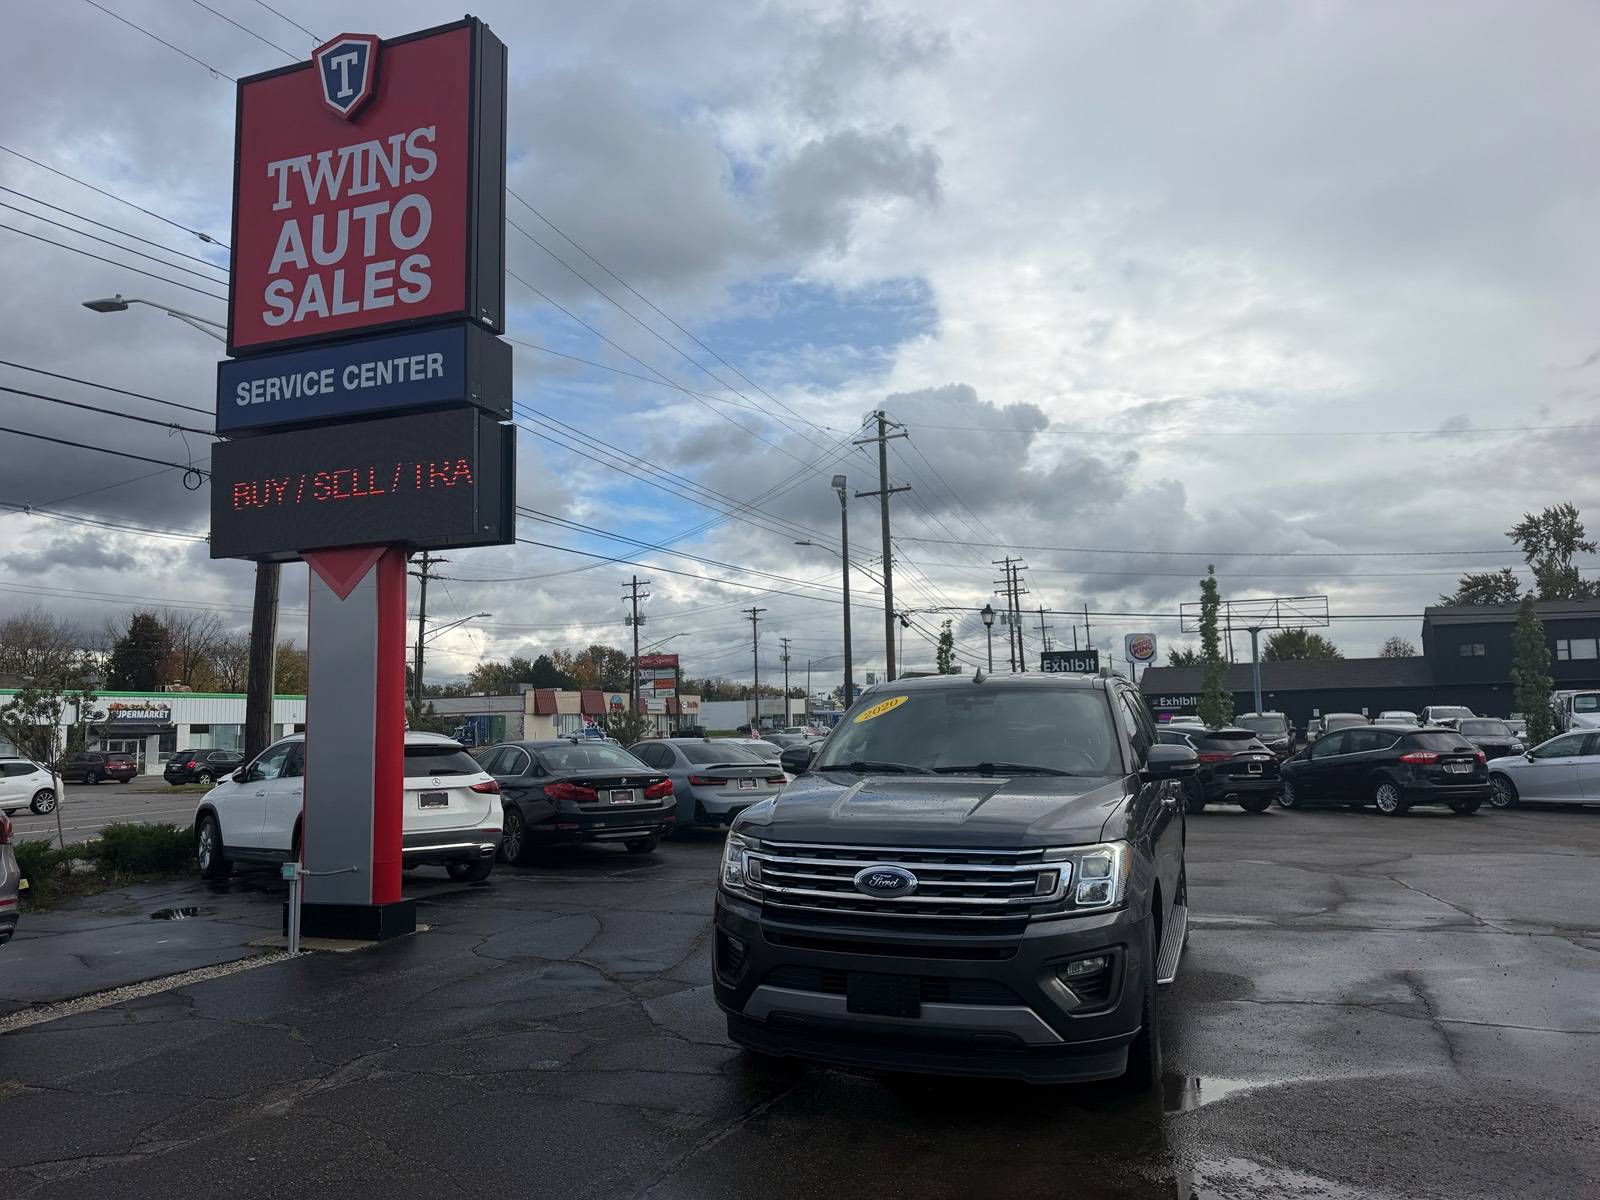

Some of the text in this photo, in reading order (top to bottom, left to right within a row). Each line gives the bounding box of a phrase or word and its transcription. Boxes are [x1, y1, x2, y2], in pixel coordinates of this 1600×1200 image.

[331, 51, 358, 99] T
[267, 125, 437, 211] TWINS
[267, 194, 432, 274] AUTO
[262, 254, 432, 327] SALES
[236, 352, 444, 406] SERVICE CENTER
[233, 476, 291, 511] BUY
[313, 466, 386, 501] SELL
[863, 699, 899, 720] 2020
[869, 873, 900, 888] Ford
